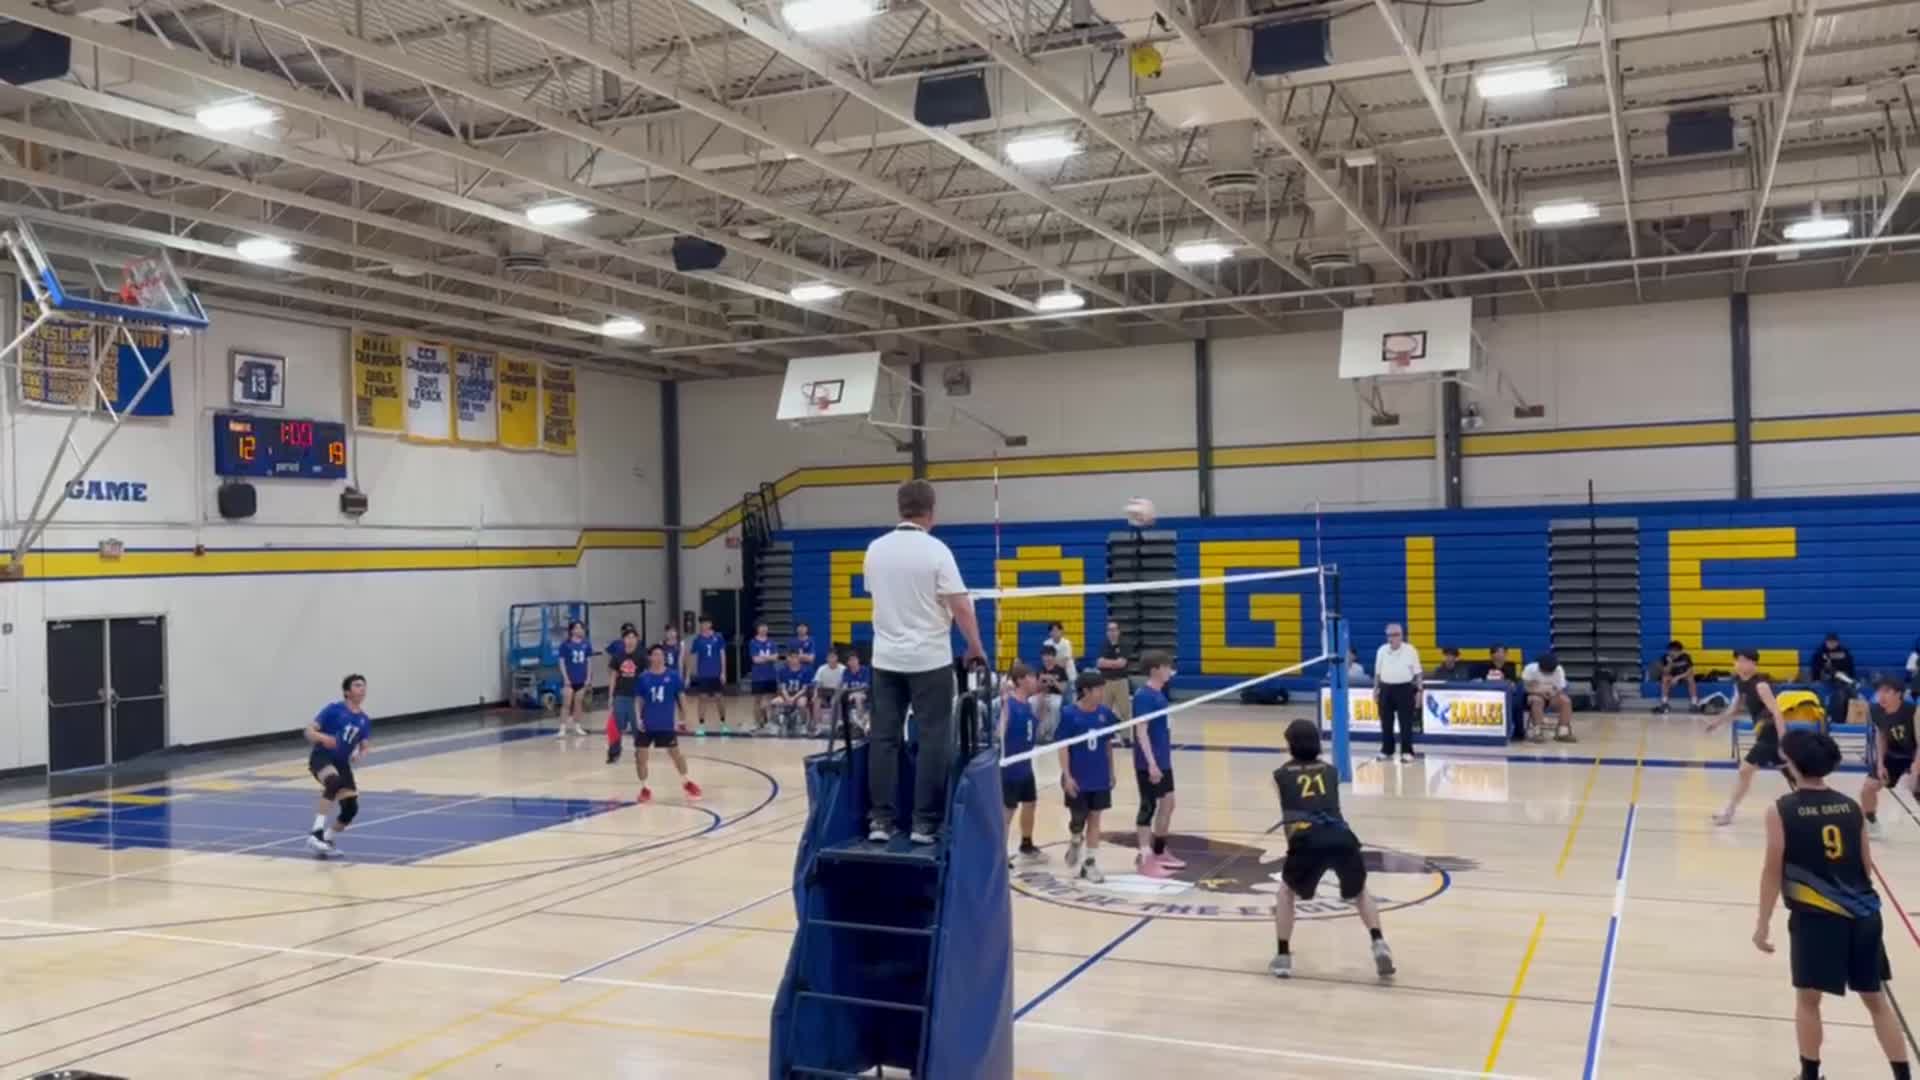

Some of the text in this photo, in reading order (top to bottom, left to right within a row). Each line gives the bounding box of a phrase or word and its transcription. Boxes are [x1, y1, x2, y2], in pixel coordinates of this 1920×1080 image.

[414, 386, 442, 402] TRACK
[281, 421, 313, 446] 1:00
[239, 435, 256, 461] 12
[328, 441, 345, 465] 19
[65, 480, 148, 502] GAME
[650, 685, 665, 702] 14
[1449, 702, 1503, 725] EAGLES
[1297, 774, 1326, 798] 21
[1798, 803, 1850, 816] OAK GROVE
[1821, 824, 1844, 860] 9
[1141, 902, 1218, 915] THE
